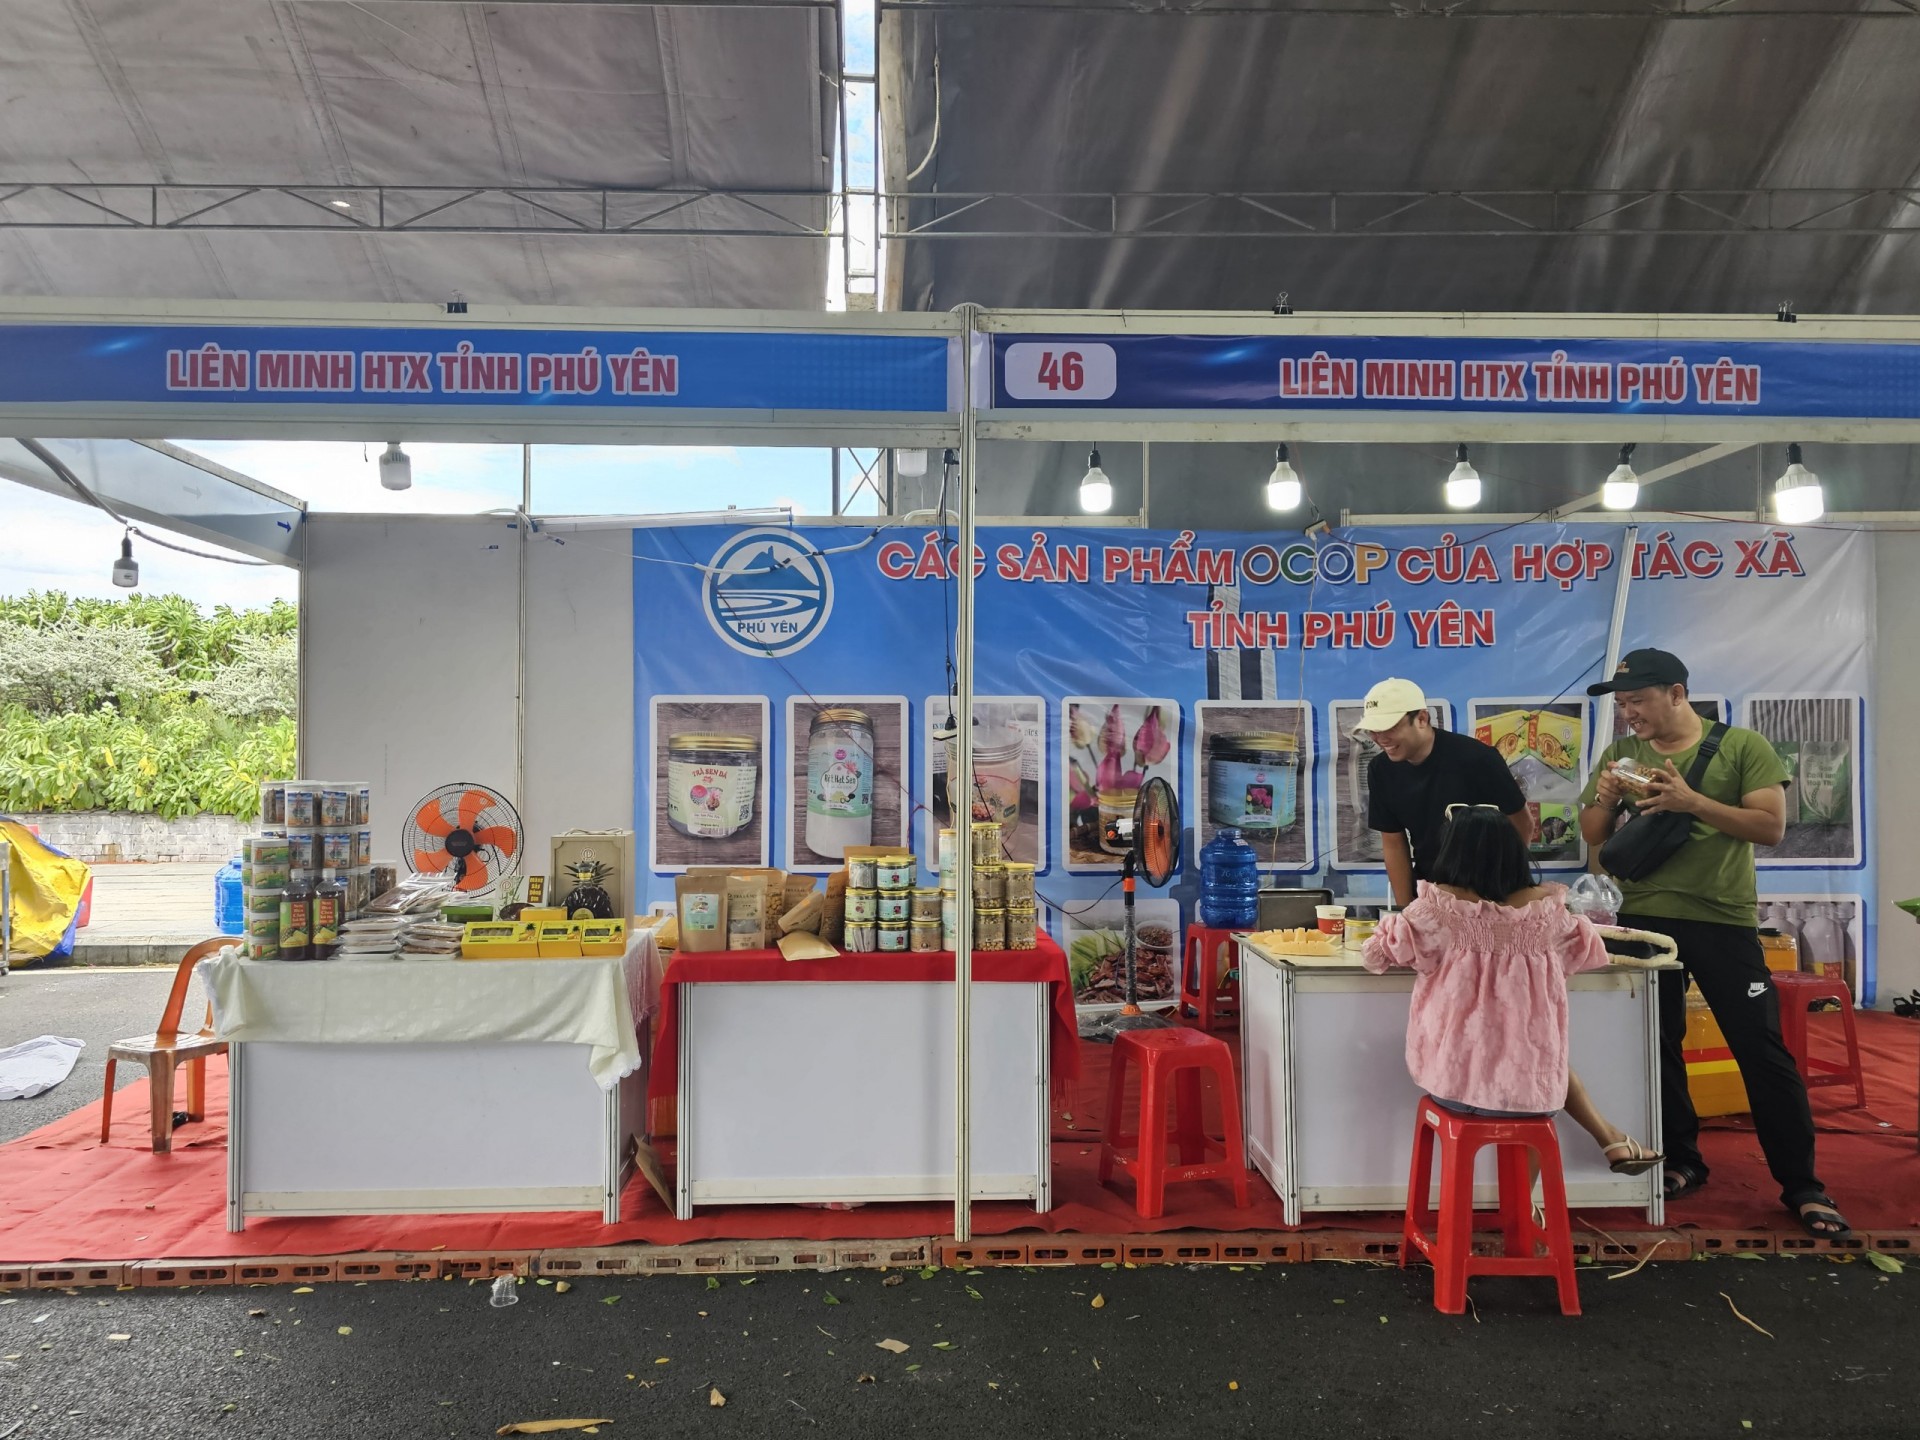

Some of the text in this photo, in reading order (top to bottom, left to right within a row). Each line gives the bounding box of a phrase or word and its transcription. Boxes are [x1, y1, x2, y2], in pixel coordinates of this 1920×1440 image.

[169, 342, 677, 394] LIÊN MINH HTX TỈNH PHÚ YÊN
[1037, 350, 1084, 391] 46
[1281, 351, 1759, 403] LIÊN MINH HTX TỈNH PHÚ YÊN
[878, 530, 1804, 591] CÁC SẢN PHẨM OCOP CỦA HỢP TÁC XÃ
[737, 619, 798, 634] PHÚ YÊN
[1187, 599, 1496, 648] TỈNH PHÚ YÊN
[705, 768, 719, 776] SEN
[1750, 982, 1765, 991] NIKE
